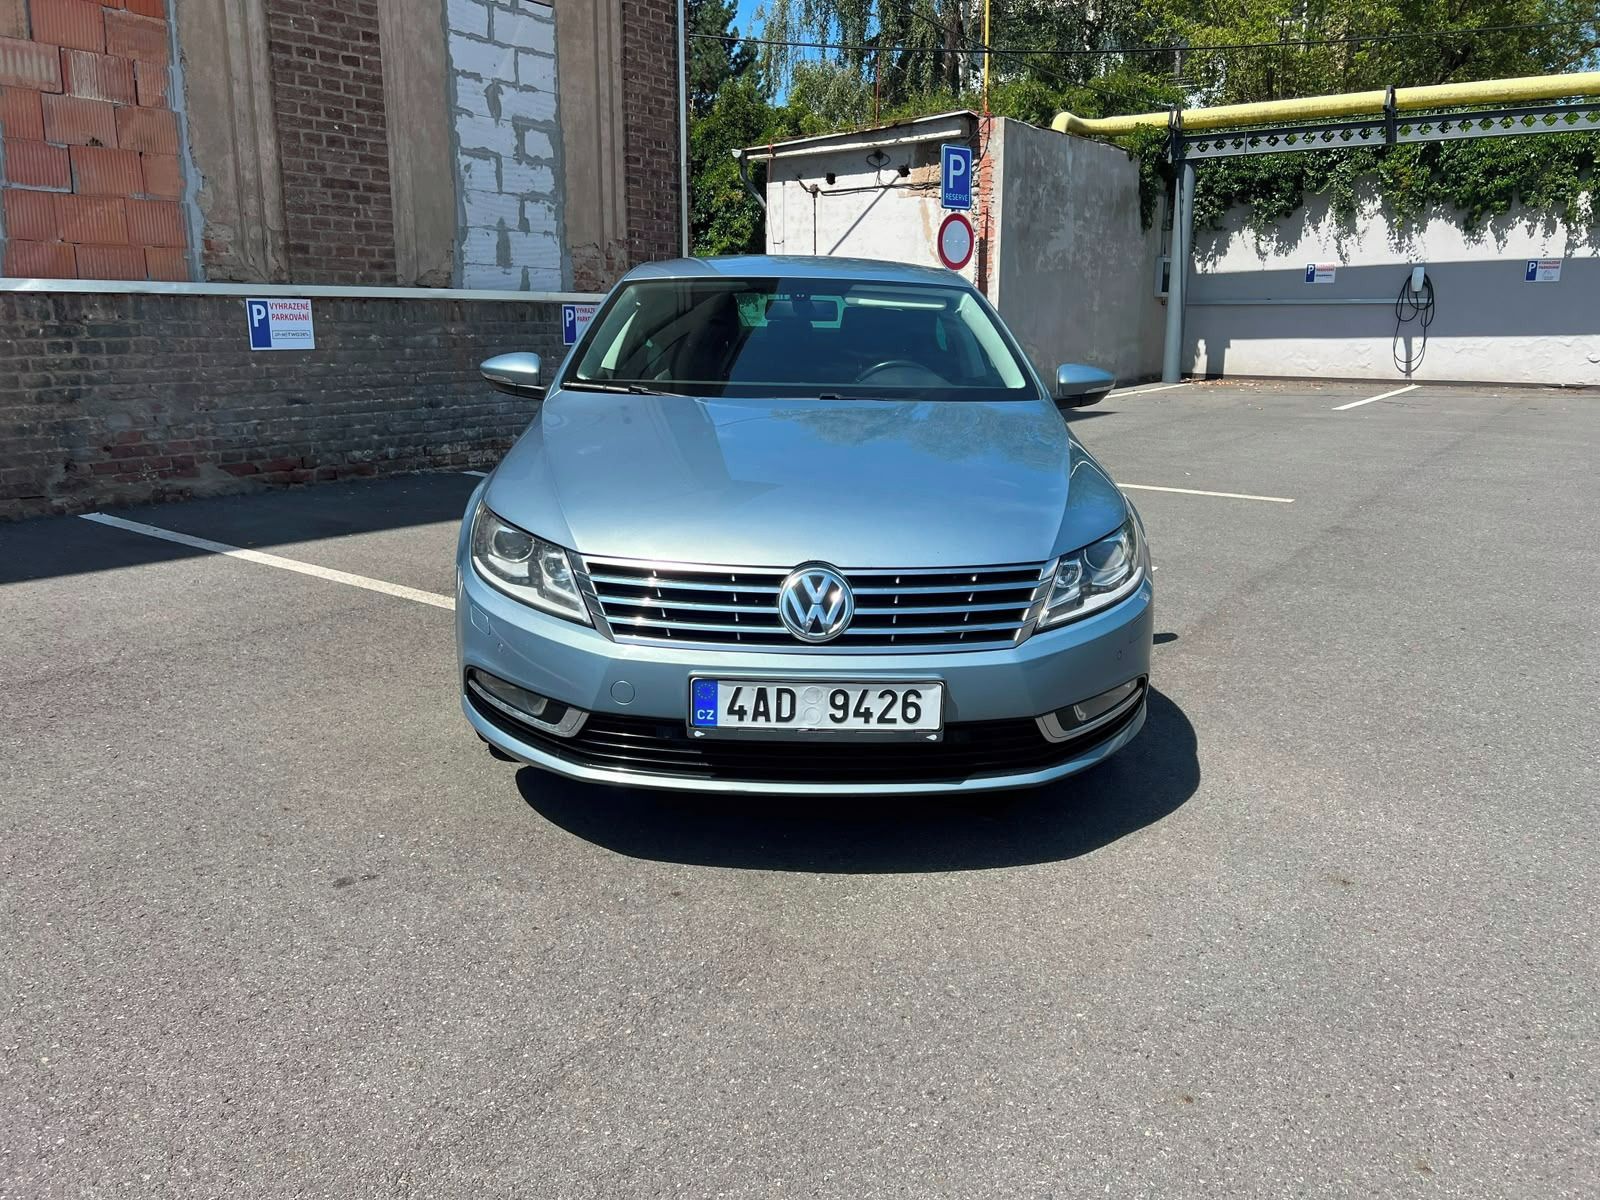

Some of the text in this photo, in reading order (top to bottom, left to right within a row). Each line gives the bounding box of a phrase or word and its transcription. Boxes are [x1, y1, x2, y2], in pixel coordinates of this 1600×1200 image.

[949, 154, 966, 189] P
[1308, 264, 1315, 275] P
[1528, 262, 1537, 273] P
[269, 301, 309, 310] VYHRAZENÉ
[251, 304, 266, 328] P
[272, 312, 310, 320] PARKOVÁNÍ
[565, 309, 575, 328] P
[782, 571, 848, 636] VW
[727, 686, 923, 725] 4AD 9426
[697, 709, 715, 721] CZ
